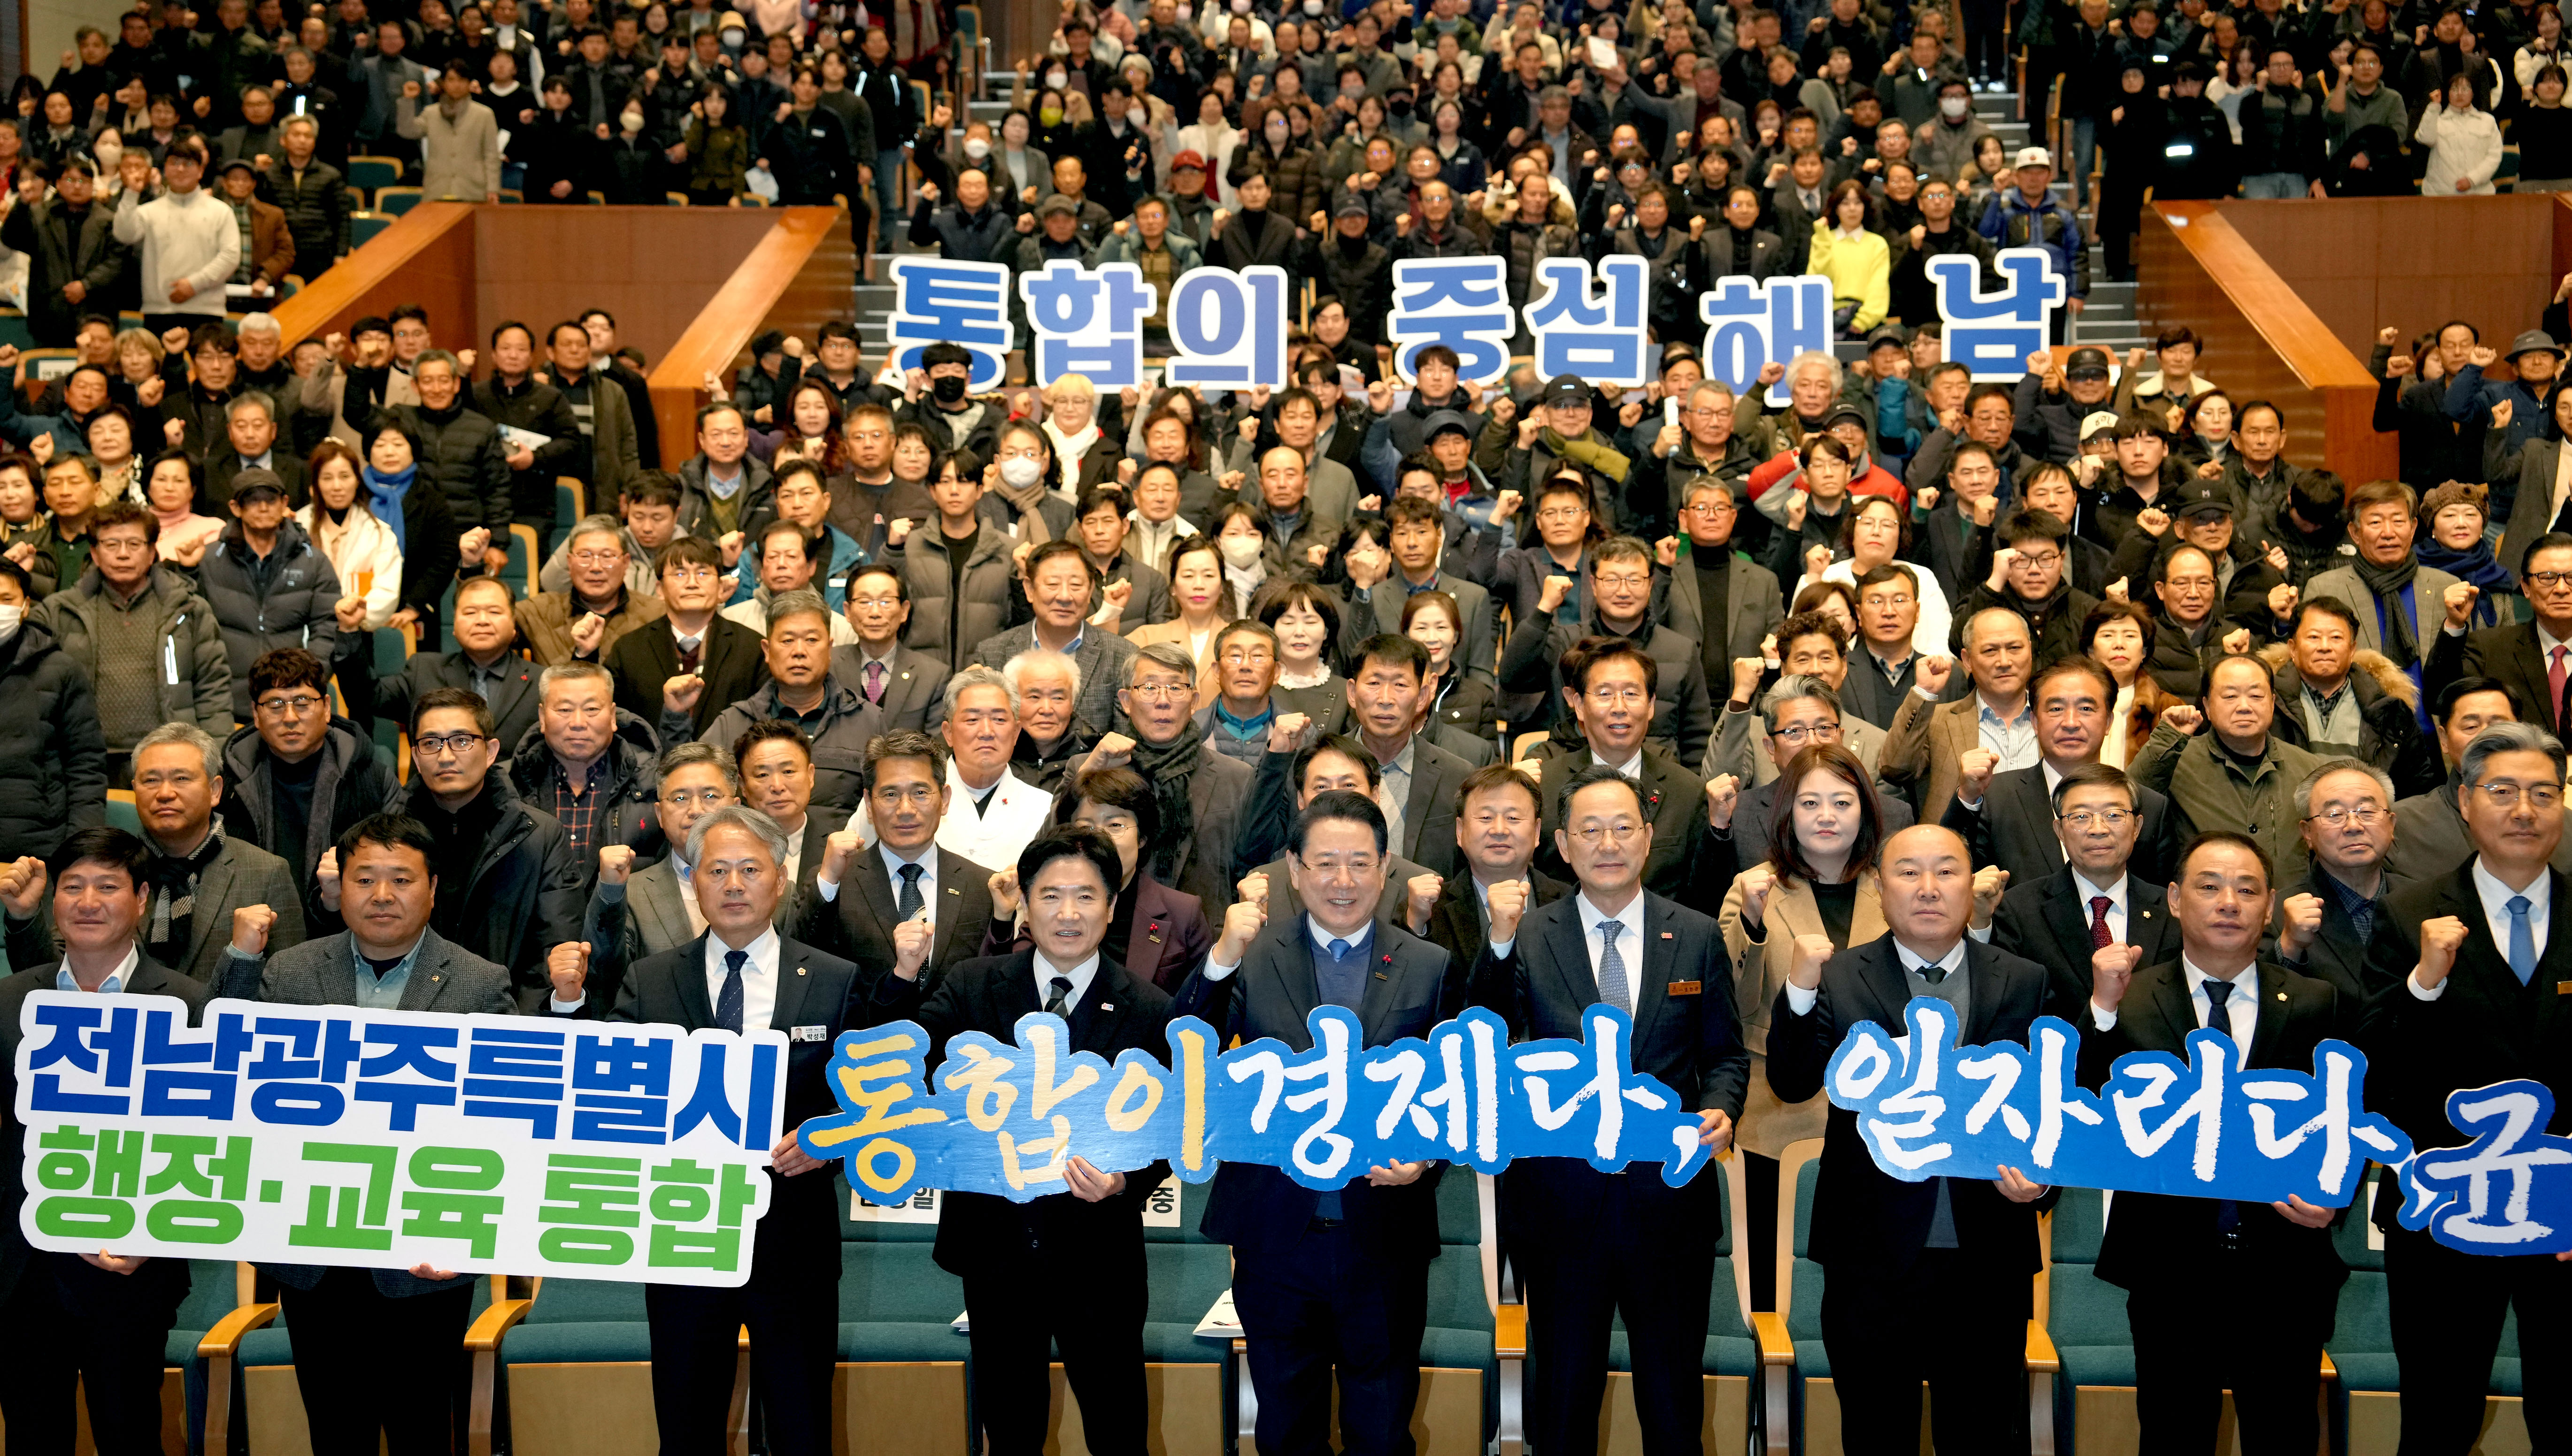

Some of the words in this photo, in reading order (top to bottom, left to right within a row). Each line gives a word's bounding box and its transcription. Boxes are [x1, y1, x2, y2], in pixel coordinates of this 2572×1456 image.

[895, 265, 1279, 385] 통합의
[1396, 264, 1640, 381] 중심
[30, 1005, 778, 1151] 전남광주특별시
[809, 1024, 1205, 1194] 통합이
[1227, 1015, 1700, 1174] 경제다,
[35, 1125, 505, 1259] 행정·교육
[539, 1154, 756, 1272] 통합
